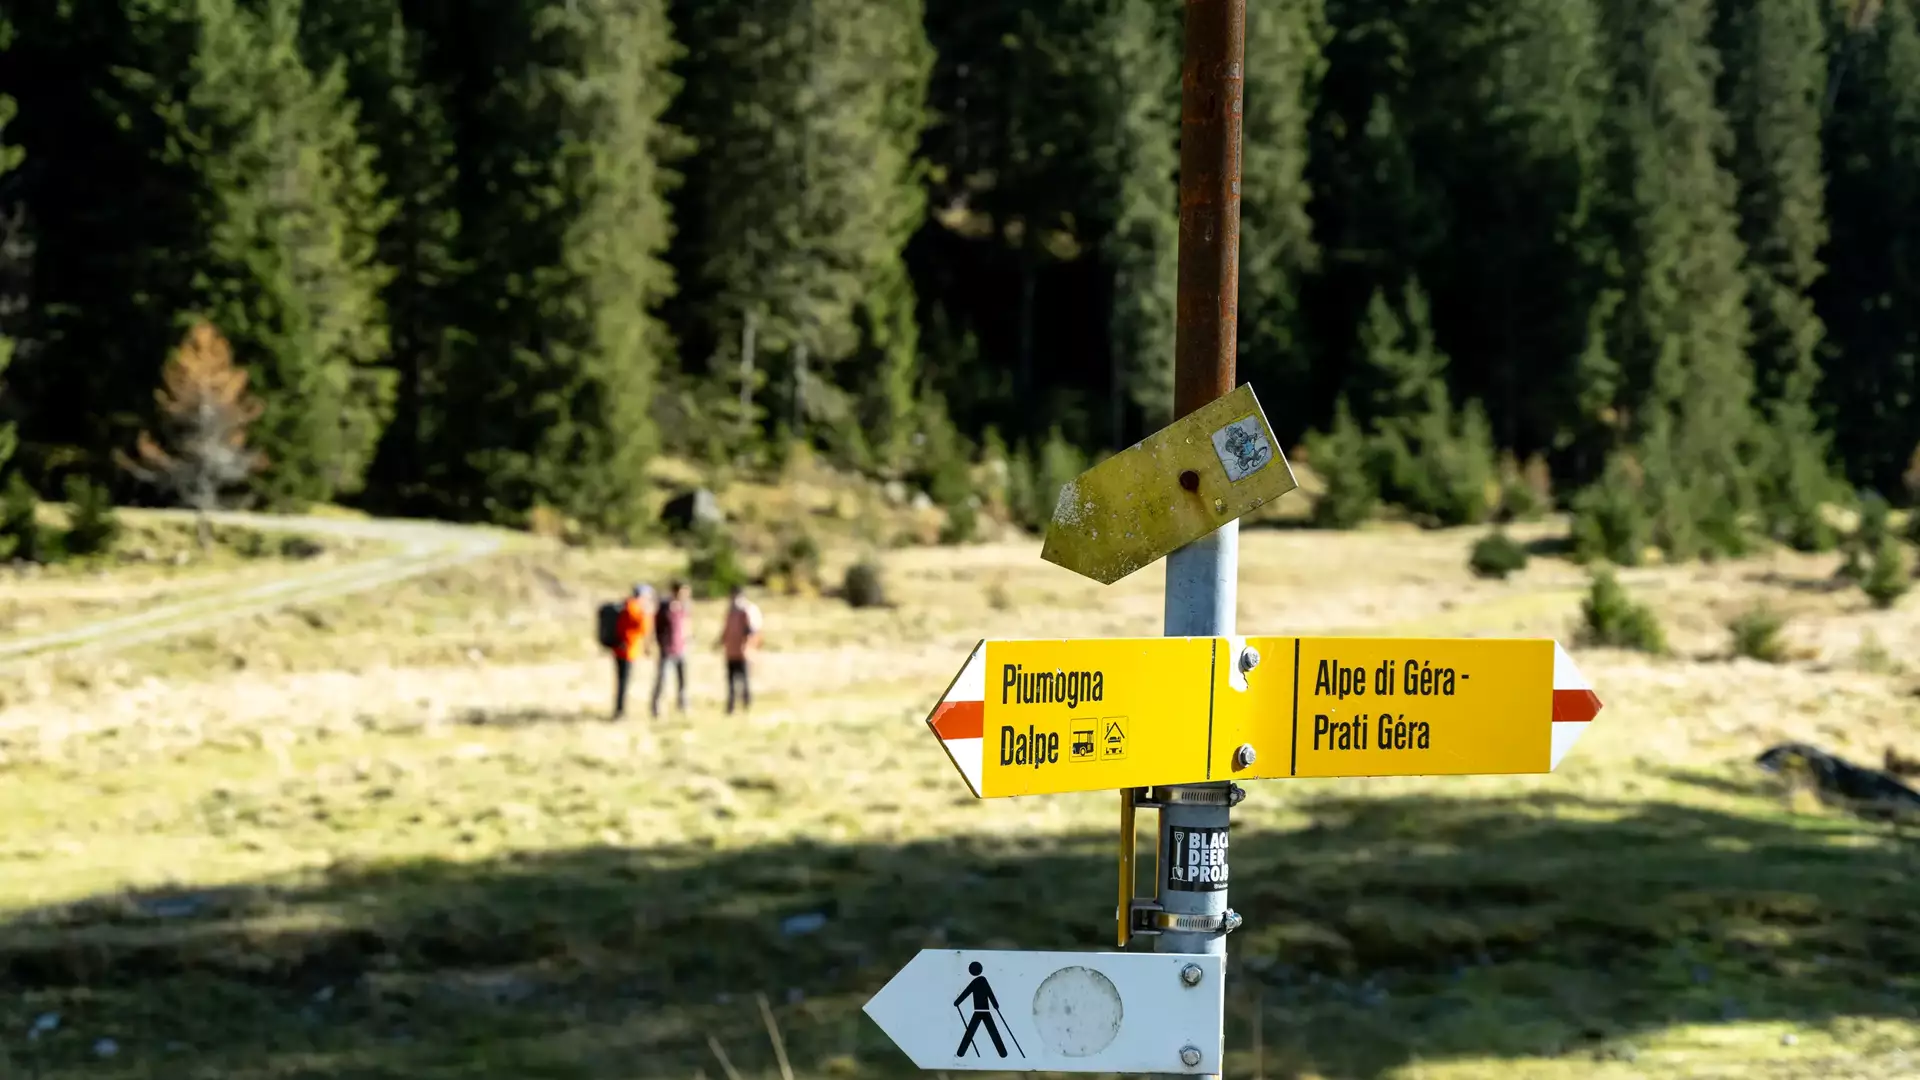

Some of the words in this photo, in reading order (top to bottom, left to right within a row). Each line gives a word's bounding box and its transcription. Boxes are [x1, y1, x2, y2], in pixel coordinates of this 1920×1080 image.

[1002, 663, 1104, 709] Piumogna
[1314, 659, 1366, 700] Alpe
[1374, 659, 1395, 696] di
[1000, 724, 1059, 769] Dalpe
[1313, 714, 1368, 750] Prati
[1377, 713, 1430, 750] Géra
[1188, 849, 1225, 866] DEER
